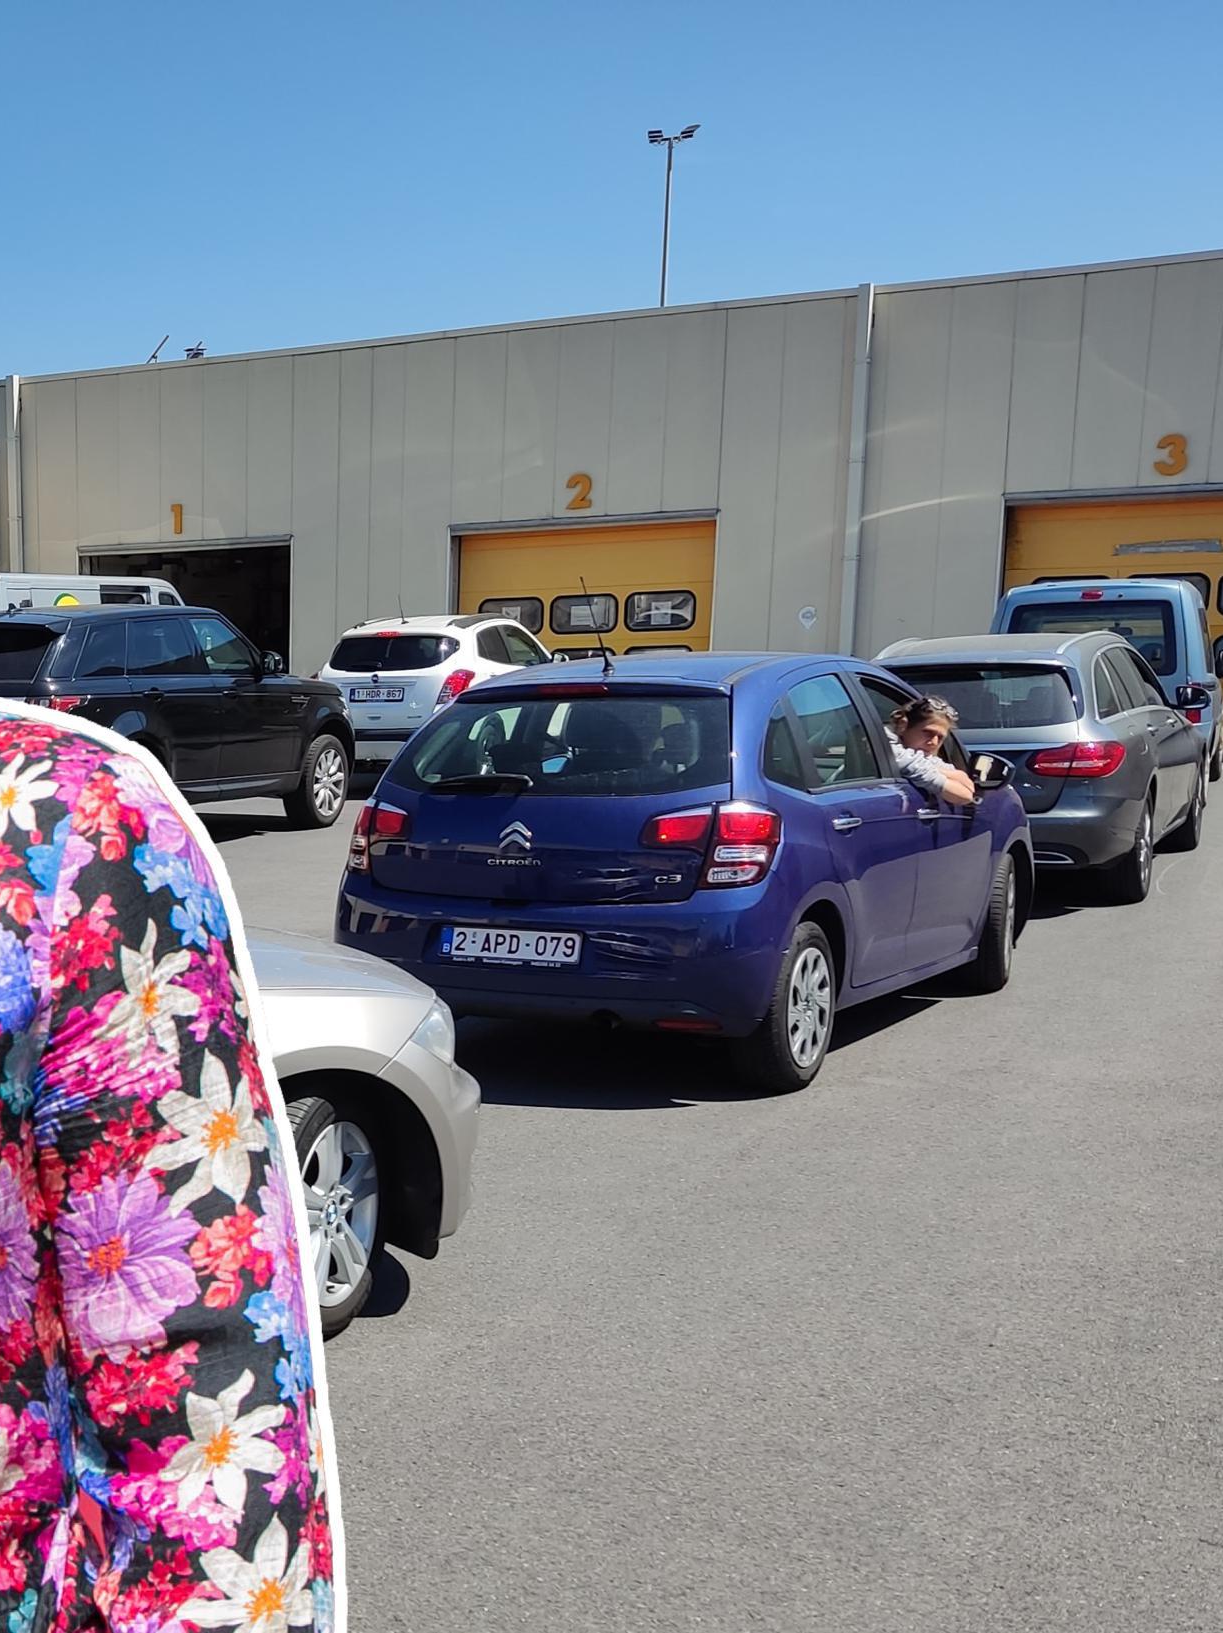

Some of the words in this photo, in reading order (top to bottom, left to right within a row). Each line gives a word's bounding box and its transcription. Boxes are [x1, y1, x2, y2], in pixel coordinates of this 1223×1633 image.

[1153, 433, 1189, 476] 3
[565, 473, 593, 510] 2
[170, 503, 183, 535] 1
[654, 874, 682, 884] C3
